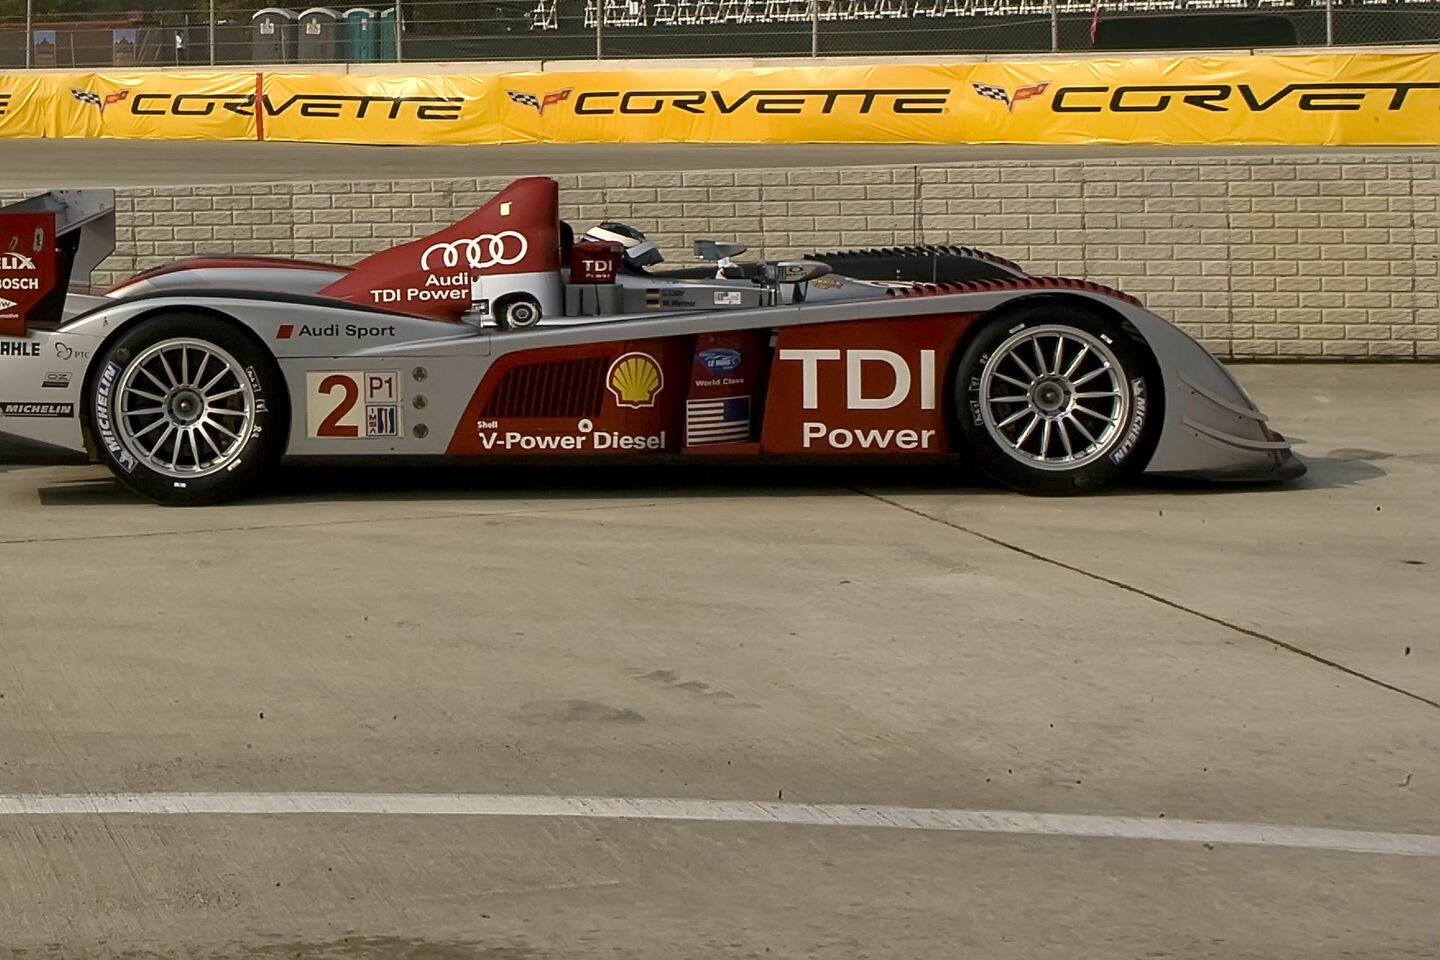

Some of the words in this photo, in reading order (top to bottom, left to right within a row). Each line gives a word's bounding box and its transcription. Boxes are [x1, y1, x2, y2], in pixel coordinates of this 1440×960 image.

[130, 93, 465, 119] CORVETTE
[574, 88, 950, 115] CORVETTE
[582, 260, 613, 272] TDI
[425, 273, 469, 286] Audi
[371, 290, 401, 303] TDI
[407, 288, 469, 301] Power
[298, 325, 339, 338] Audi
[345, 325, 395, 340] Sport
[369, 376, 393, 398] P1
[695, 379, 721, 387] World
[779, 349, 936, 410] TDI
[5, 404, 72, 414] MICHELIN
[97, 365, 121, 452] MICHELIN
[316, 374, 359, 437] 2
[369, 407, 377, 434] IMSA
[477, 421, 498, 429] Shell
[1114, 397, 1146, 461] MICHELIN
[479, 433, 586, 450] V-Power
[593, 431, 666, 449] Diesel
[802, 421, 936, 449] Power
